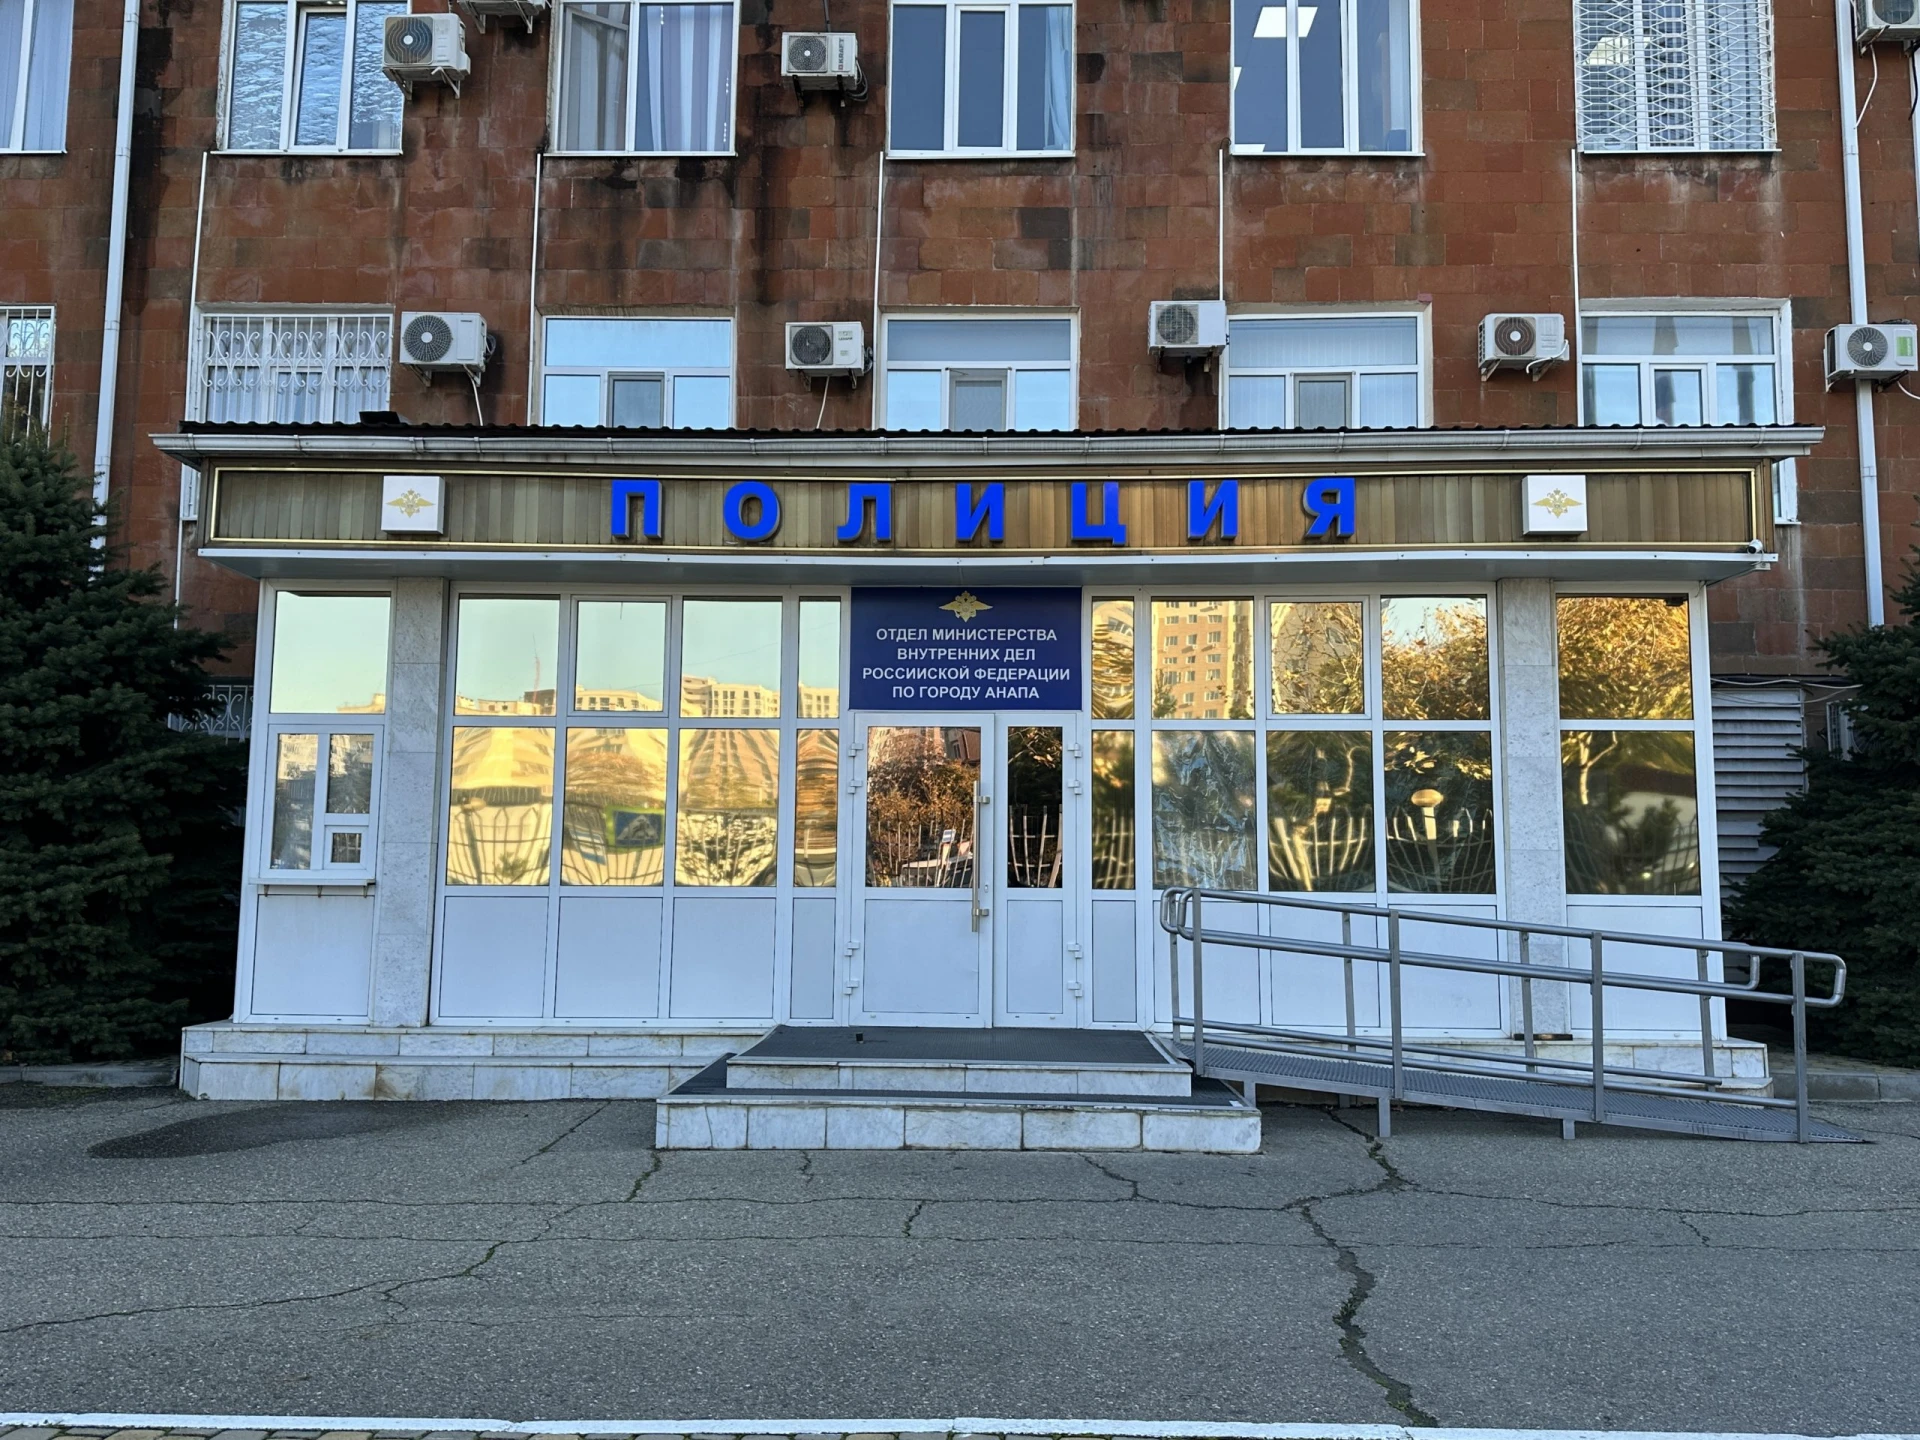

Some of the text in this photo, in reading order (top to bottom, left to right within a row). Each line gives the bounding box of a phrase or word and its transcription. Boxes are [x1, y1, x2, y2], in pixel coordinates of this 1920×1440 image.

[612, 478, 1355, 545] ПОЛИЦИЯ
[876, 628, 1058, 642] ОТДЕЛ МИНИСТЕРСТВА
[897, 647, 1036, 662] ВНУТРЕННИХ ДЕЛ
[974, 667, 1070, 682] ФЕДЕРАЦИИ
[892, 686, 1040, 700] ПО ГОРОДУ АНАПА
